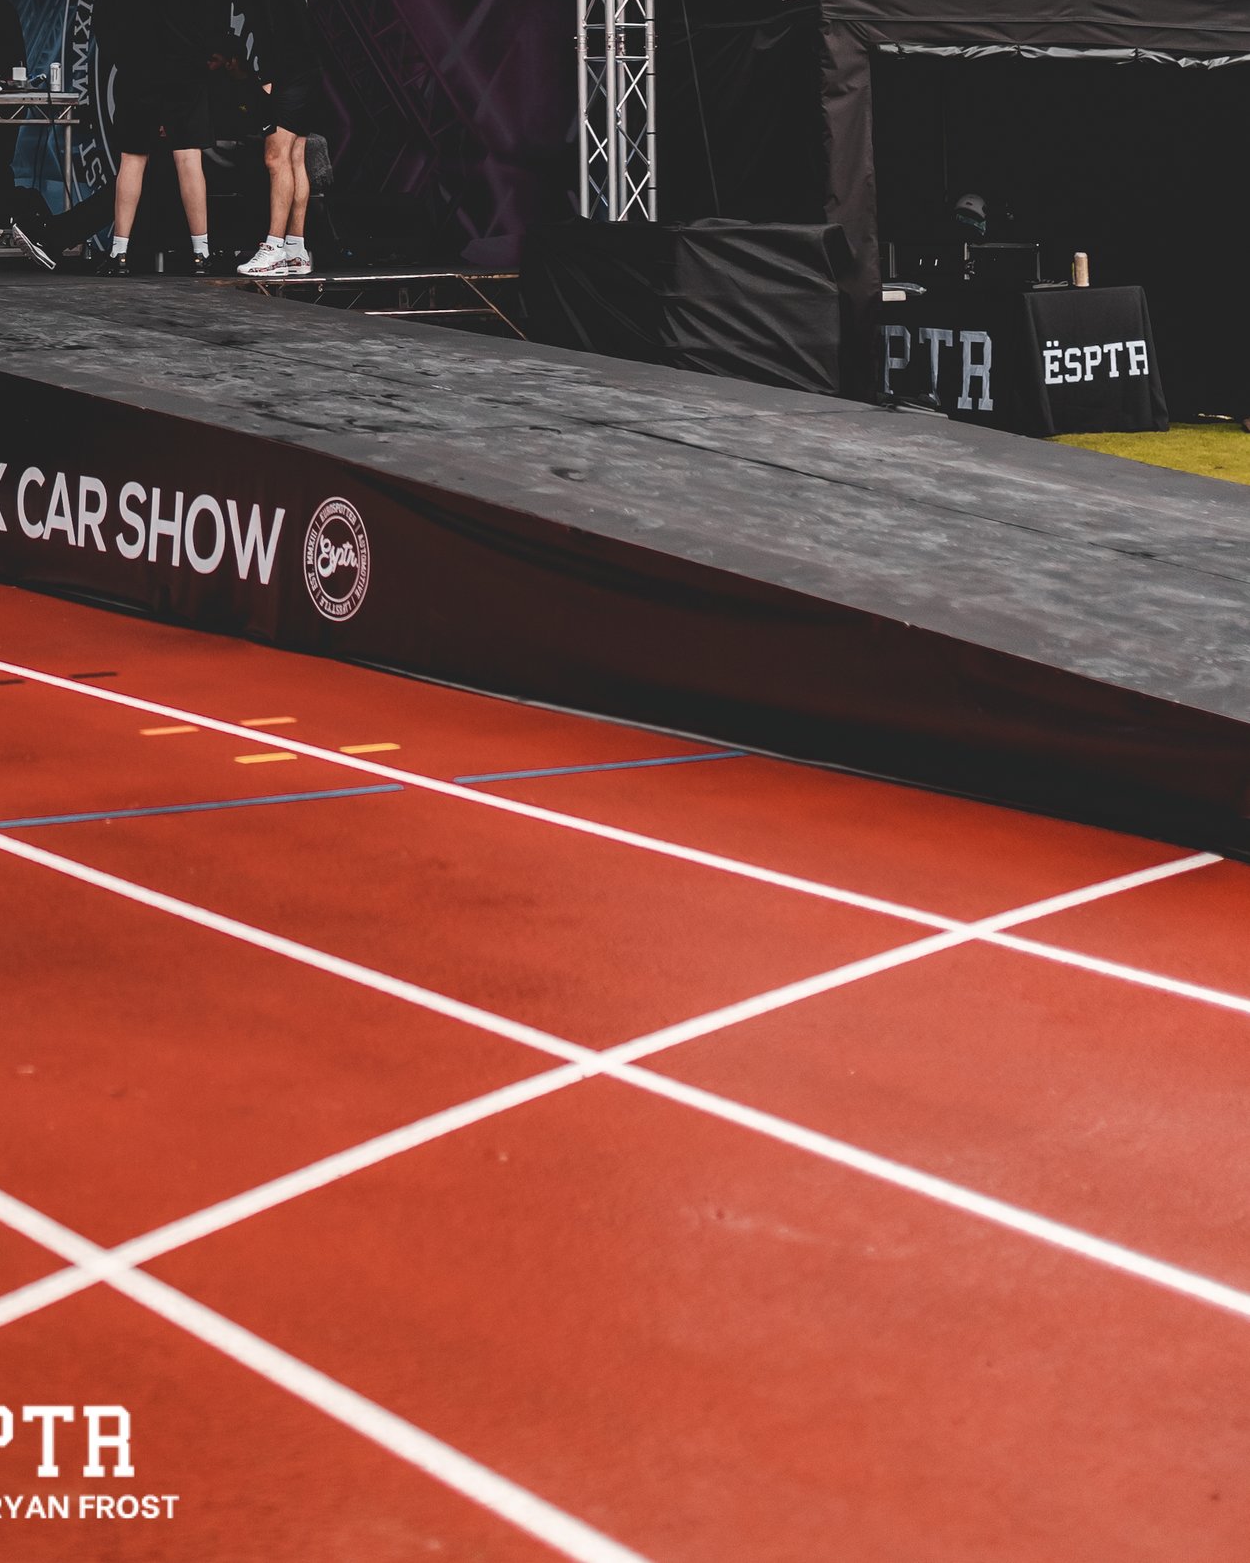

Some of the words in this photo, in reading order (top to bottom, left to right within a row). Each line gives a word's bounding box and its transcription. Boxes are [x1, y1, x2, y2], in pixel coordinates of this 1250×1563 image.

[1043, 340, 1149, 385] ËSPTR
[17, 466, 108, 553] CAR
[115, 481, 286, 585] SHOW
